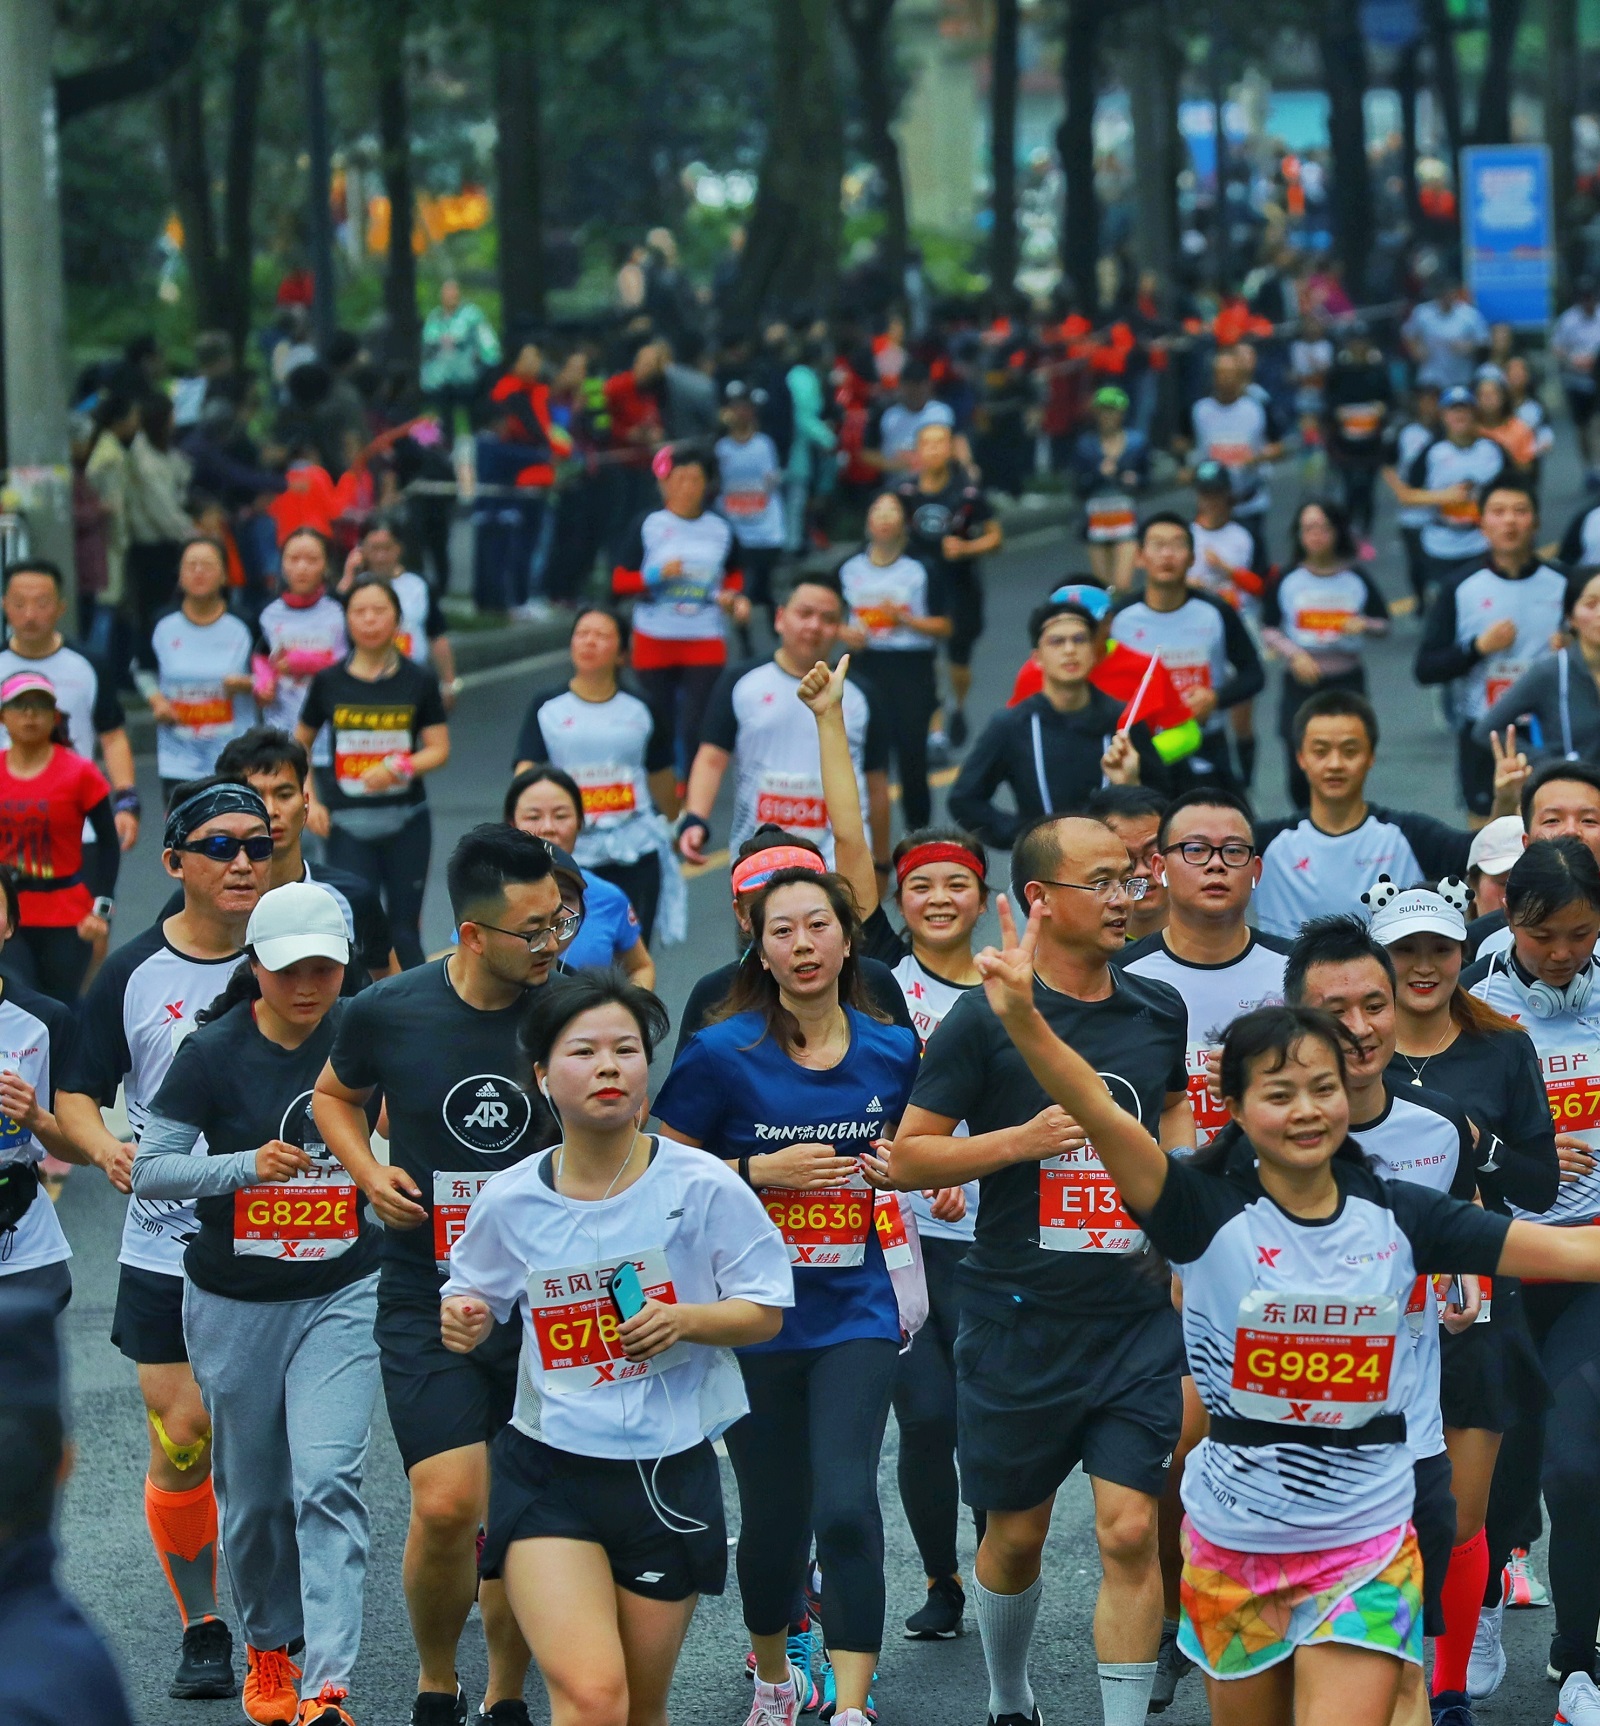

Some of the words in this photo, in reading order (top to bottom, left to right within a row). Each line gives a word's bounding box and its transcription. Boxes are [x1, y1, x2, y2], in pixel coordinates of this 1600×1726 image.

[1398, 904, 1439, 914] SUUNTO
[462, 1101, 509, 1128] AR
[753, 1123, 800, 1141] RUN
[816, 1119, 881, 1141] OCEANS
[1061, 1186, 1128, 1213] E13
[141, 1217, 164, 1237] 2019
[764, 1201, 863, 1230] G8636
[1262, 1303, 1377, 1326] 东风日产
[1247, 1348, 1381, 1384] G9824
